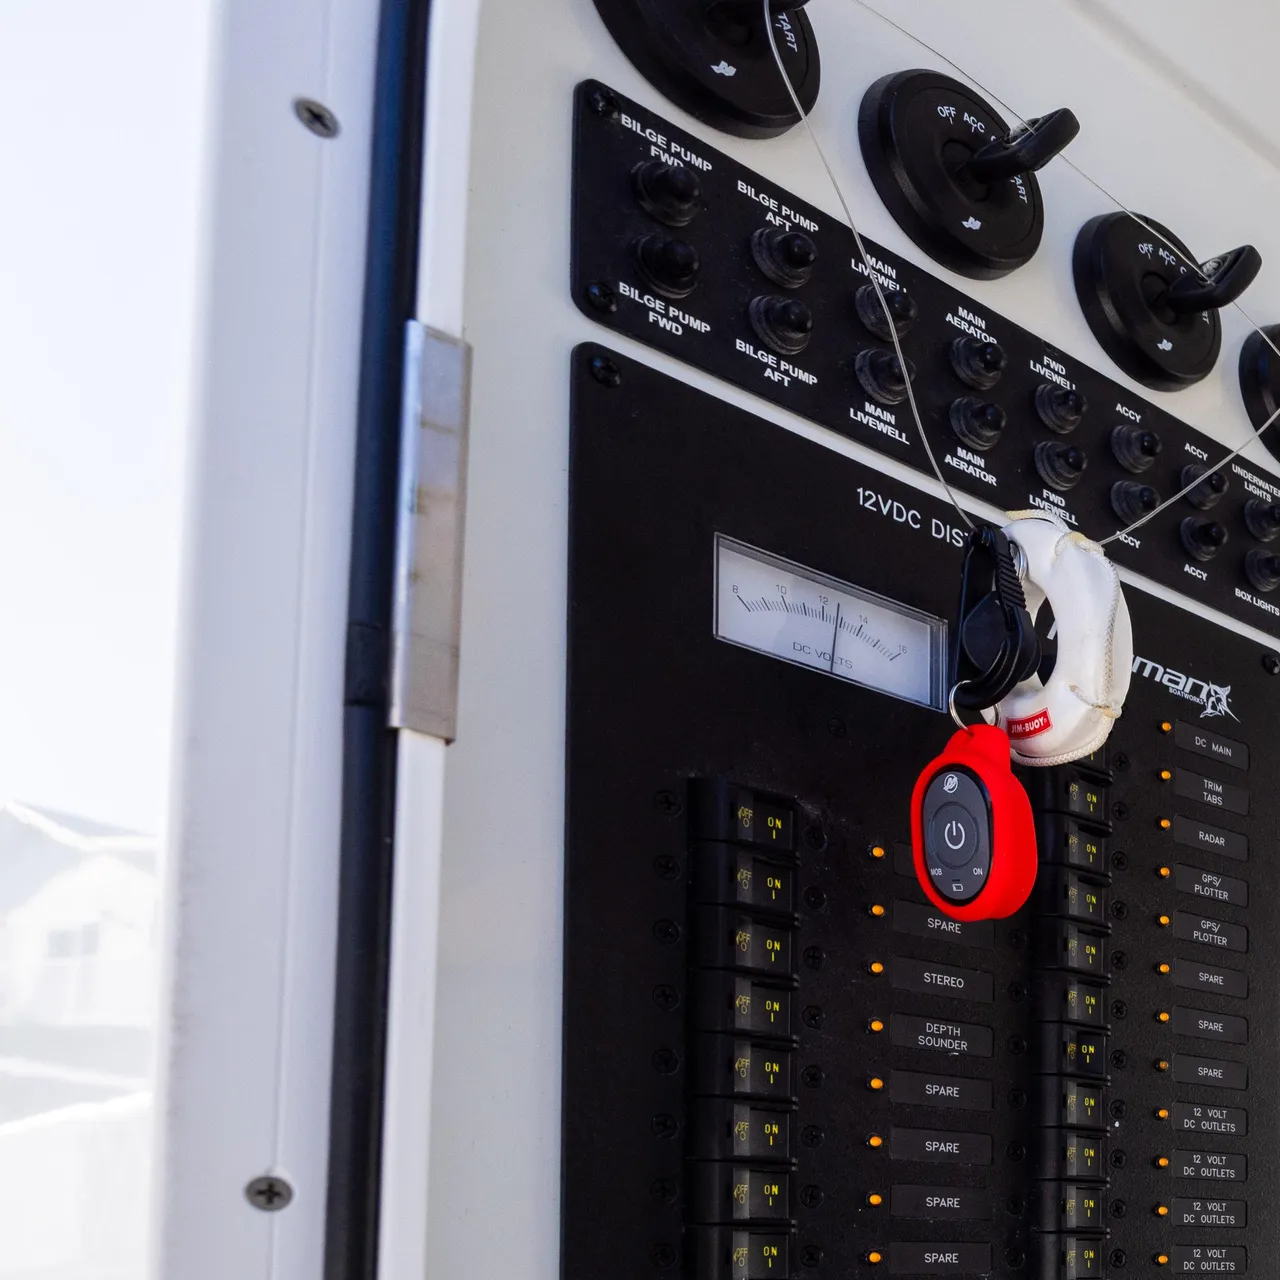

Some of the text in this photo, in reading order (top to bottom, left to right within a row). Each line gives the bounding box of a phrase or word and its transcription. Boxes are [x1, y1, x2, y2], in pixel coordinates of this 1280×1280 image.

[937, 106, 985, 133] OFF ACC
[621, 115, 712, 171] BILGE PUMP
[650, 146, 683, 168] FWD
[737, 180, 819, 232] BILGE PUMP
[766, 212, 792, 231] AFT
[1139, 243, 1176, 265] OFF ACC
[866, 254, 896, 279] MAIN
[619, 283, 711, 333] BILGE PUMP
[649, 312, 682, 336] FWD
[958, 307, 985, 330] MAIN
[736, 339, 817, 386] BILGE PUMP
[1044, 356, 1066, 375] FWD
[765, 369, 790, 387] AFT
[865, 402, 895, 424] MAIN
[1116, 403, 1141, 423] ACCY
[850, 408, 910, 445] LIVEWELL
[957, 447, 984, 468] MAIN
[1185, 443, 1208, 461] ACCY
[945, 454, 997, 486] AERATOR
[1043, 489, 1065, 507] FWD
[1245, 482, 1271, 503] LIGHTS
[857, 487, 921, 529] 12VDC
[1029, 494, 1078, 525] LIVEWELL
[1116, 531, 1141, 549] ACCY
[1184, 564, 1207, 581] ACCY
[733, 585, 868, 625] 8 10 12 14
[1235, 588, 1280, 616] BOX LIGHTS
[793, 642, 852, 669] DC VOLTS
[1195, 737, 1232, 757] DC MAIN
[1204, 780, 1222, 793] TRIM
[1203, 792, 1222, 805] TABS
[768, 817, 781, 829] ON
[1199, 831, 1225, 846] RADAR
[931, 868, 983, 876] MOB ON
[1202, 874, 1221, 887] GPS/
[1195, 884, 1228, 900] PLOTTER
[928, 918, 961, 933] SPARE
[1201, 920, 1220, 933] GPS/
[1194, 931, 1227, 946] PLOTTER
[924, 973, 964, 988] STEREO
[1199, 973, 1224, 985] SPARE
[926, 1023, 961, 1036] DEPTH
[1199, 1020, 1223, 1032] SPARE
[918, 1036, 967, 1051] SOUNDER
[1198, 1067, 1223, 1078] SPARE
[926, 1085, 959, 1097] SPARE
[1194, 1108, 1227, 1119] 12 VOLT
[1184, 1119, 1235, 1132] DC OUTLETS
[926, 1141, 959, 1153] SPARE
[1193, 1155, 1226, 1165] 12 VOLT
[1184, 1167, 1235, 1178] DC OUTLETS
[926, 1197, 960, 1208] SPARE
[1193, 1202, 1226, 1211] 12 VOLT
[1184, 1214, 1235, 1224] DC OUTLETS
[924, 1253, 958, 1263] SPARE
[1193, 1249, 1226, 1258] 12 VOLT
[1184, 1262, 1235, 1270] DC OUTLETS
